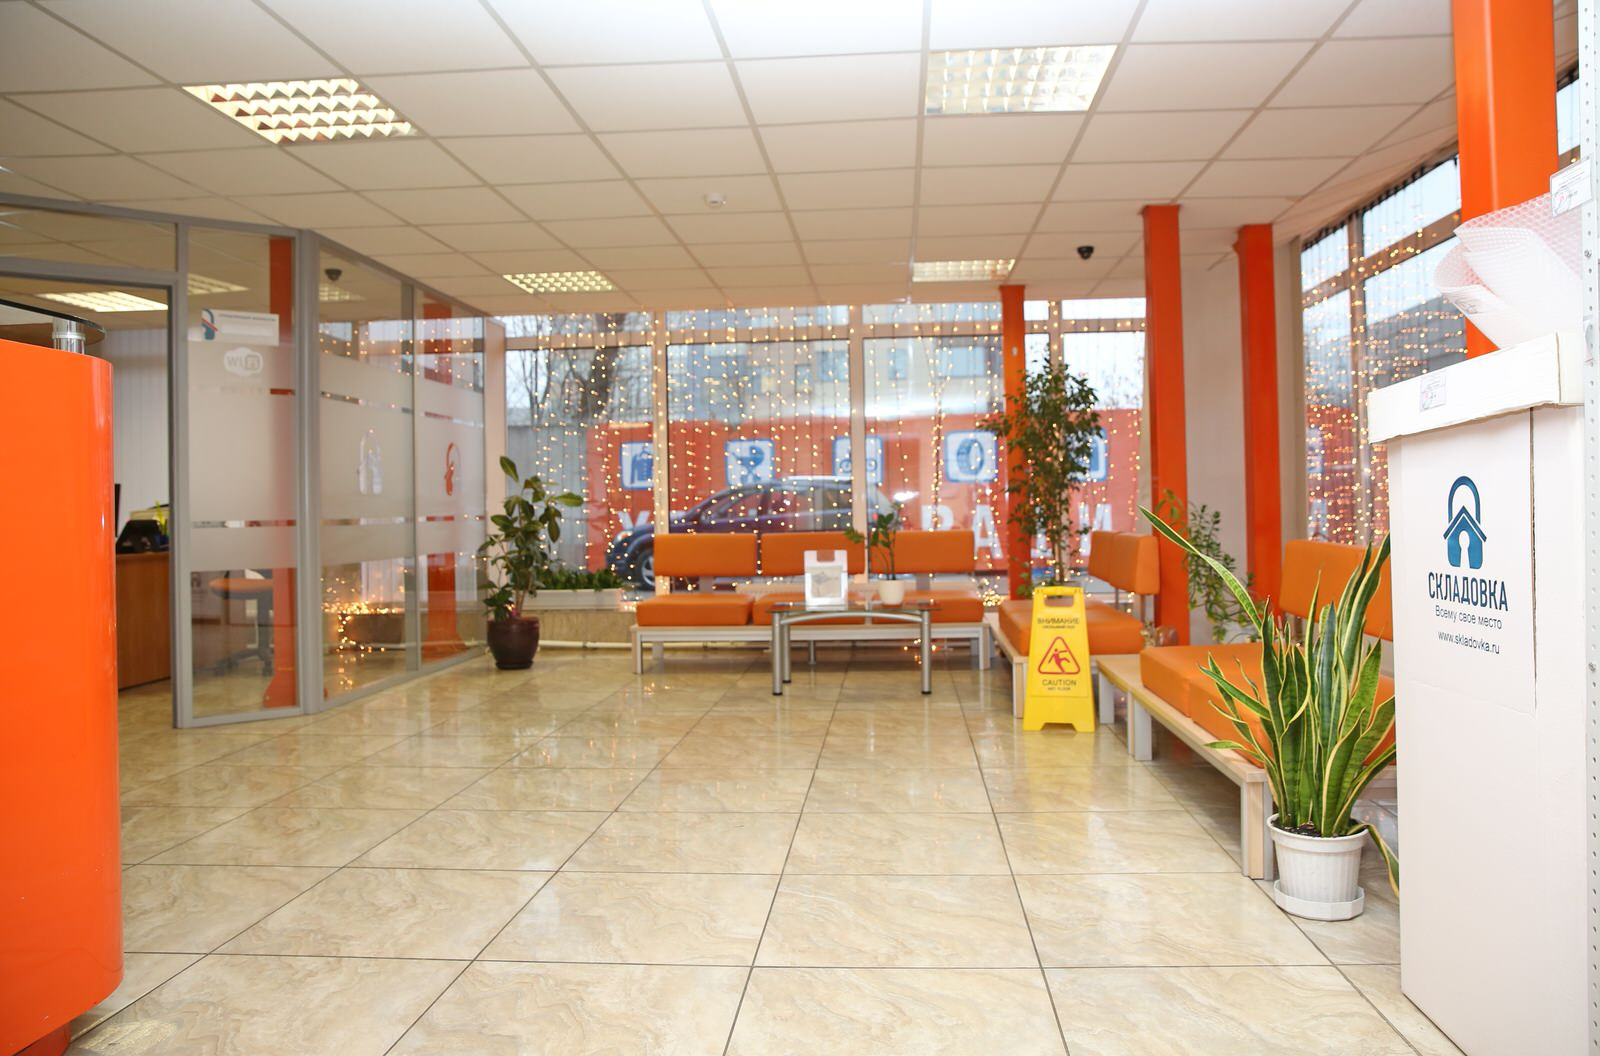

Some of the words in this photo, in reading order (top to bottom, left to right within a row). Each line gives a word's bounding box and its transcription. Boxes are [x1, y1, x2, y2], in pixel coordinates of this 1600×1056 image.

[1428, 571, 1509, 612] СКЛАДОВКА
[1435, 604, 1458, 623] Всему
[1458, 612, 1476, 625] свое
[1478, 616, 1503, 630] место
[1438, 631, 1500, 655] www.skladovka.ru
[1042, 679, 1077, 687] CAUTION
